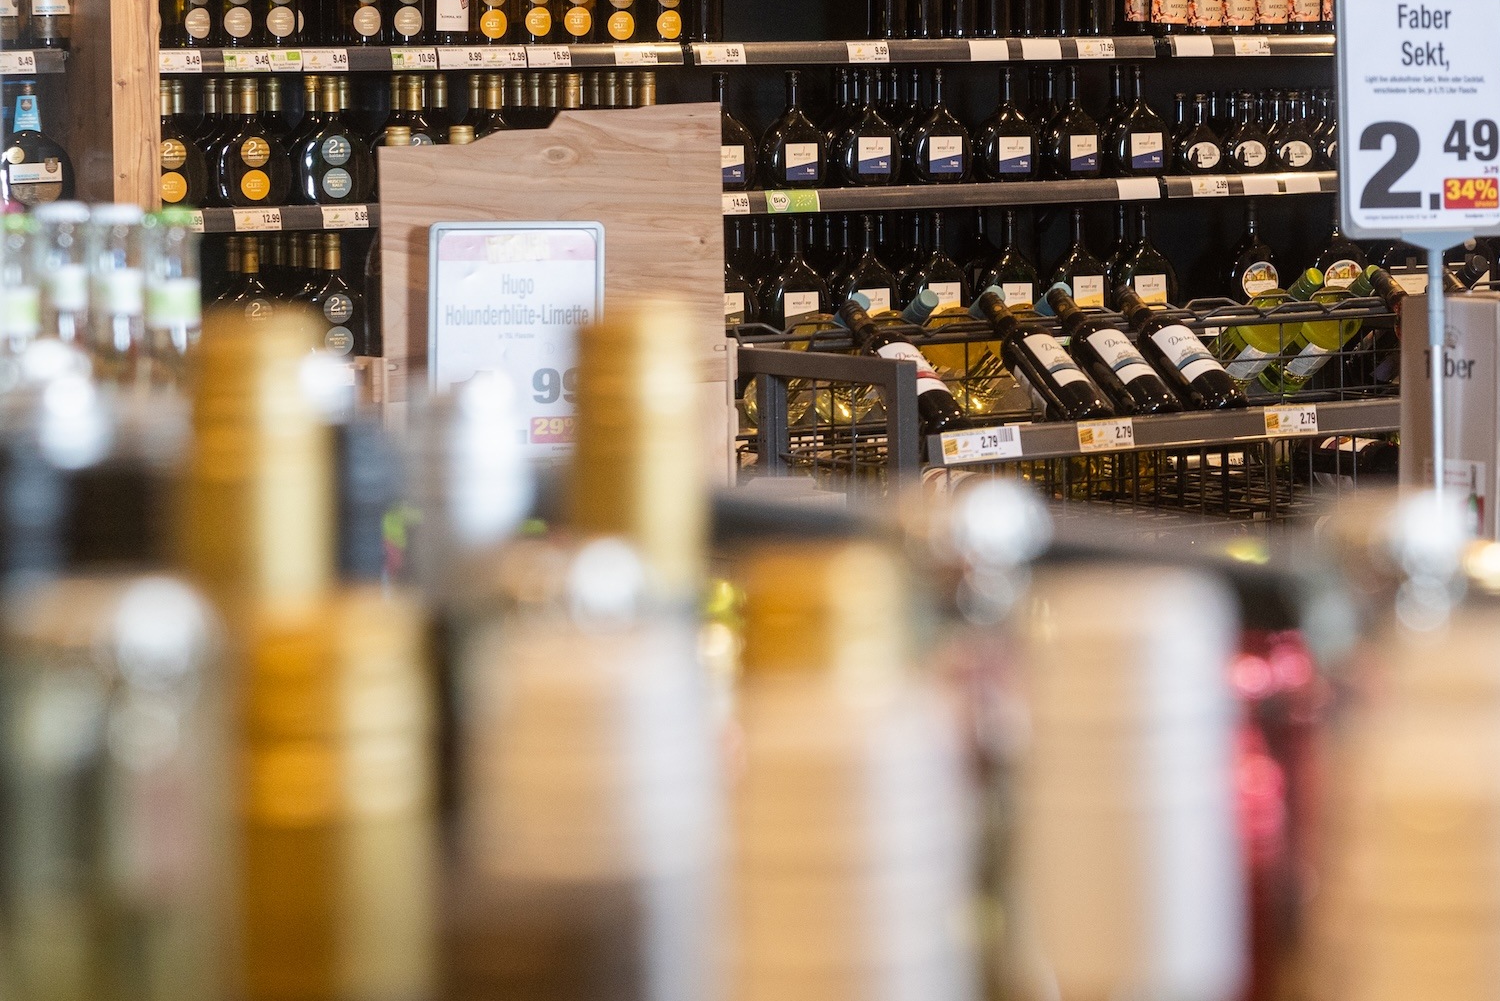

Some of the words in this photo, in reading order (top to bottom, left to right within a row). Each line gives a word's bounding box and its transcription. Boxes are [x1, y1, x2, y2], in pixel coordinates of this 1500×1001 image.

[1397, 4, 1452, 29] Faber
[726, 48, 740, 57] 9.99
[874, 46, 888, 55] 9.99
[1100, 44, 1115, 52] 17.99
[18, 56, 34, 67] 8.49
[186, 55, 201, 65] 9.49
[255, 55, 269, 65] 9.49
[332, 54, 347, 63] 9.49
[418, 53, 436, 63] 10.99
[468, 52, 483, 61] 8.99
[508, 52, 526, 61] 12.99
[553, 51, 570, 61] 16.99
[1401, 41, 1450, 71] Sekt,
[1359, 121, 1441, 211] 2.
[1443, 119, 1499, 162] 49
[1215, 180, 1228, 190] 2.99
[1446, 179, 1498, 201] 34%
[732, 197, 748, 208] 14.99
[262, 213, 281, 224] 12.99
[354, 211, 369, 221] 8.99
[502, 274, 534, 299] Hugo
[445, 304, 589, 327] Holunderblüte-Limette
[1424, 350, 1475, 379] ber
[1299, 411, 1317, 425] 2.79
[1115, 425, 1132, 439] 2.79
[980, 435, 999, 449] 2.79
